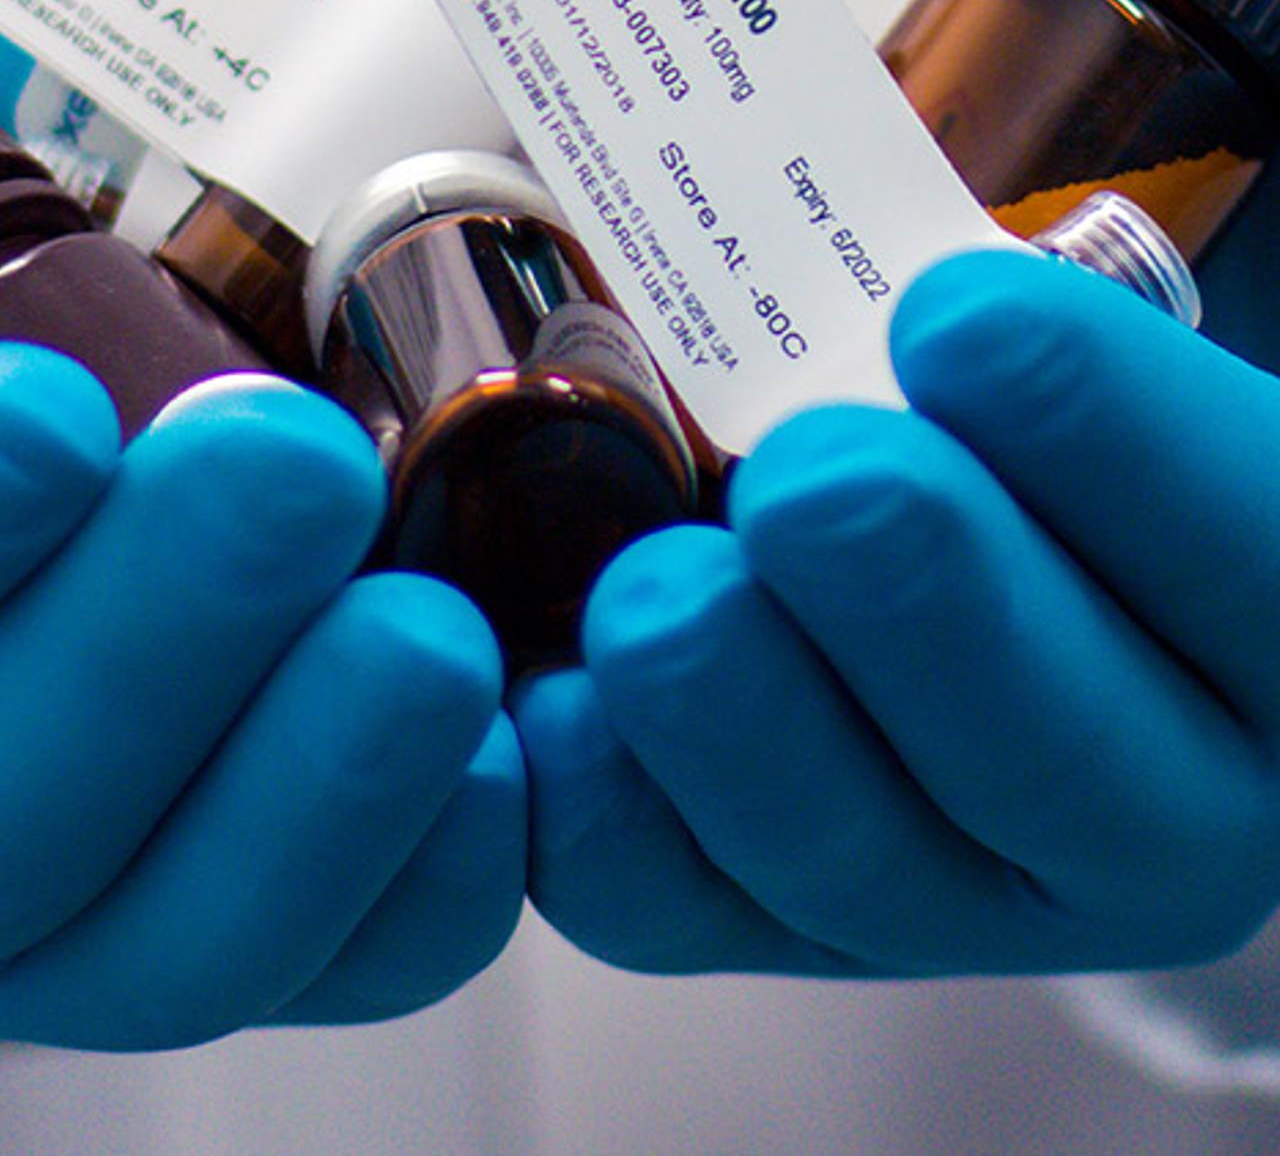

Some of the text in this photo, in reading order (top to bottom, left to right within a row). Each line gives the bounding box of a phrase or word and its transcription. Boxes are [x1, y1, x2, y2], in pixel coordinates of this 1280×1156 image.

[161, 8, 204, 44] At:
[105, 56, 142, 88] USE
[705, 27, 756, 103] 100mg
[548, 120, 581, 164] FOR
[575, 163, 648, 272] RESEARCH
[641, 271, 674, 316] USE
[668, 315, 709, 366] ONLY
[659, 141, 808, 360] Store At: -80C
[783, 156, 891, 302] Expiry: 6/2022
[709, 336, 739, 371] USA
